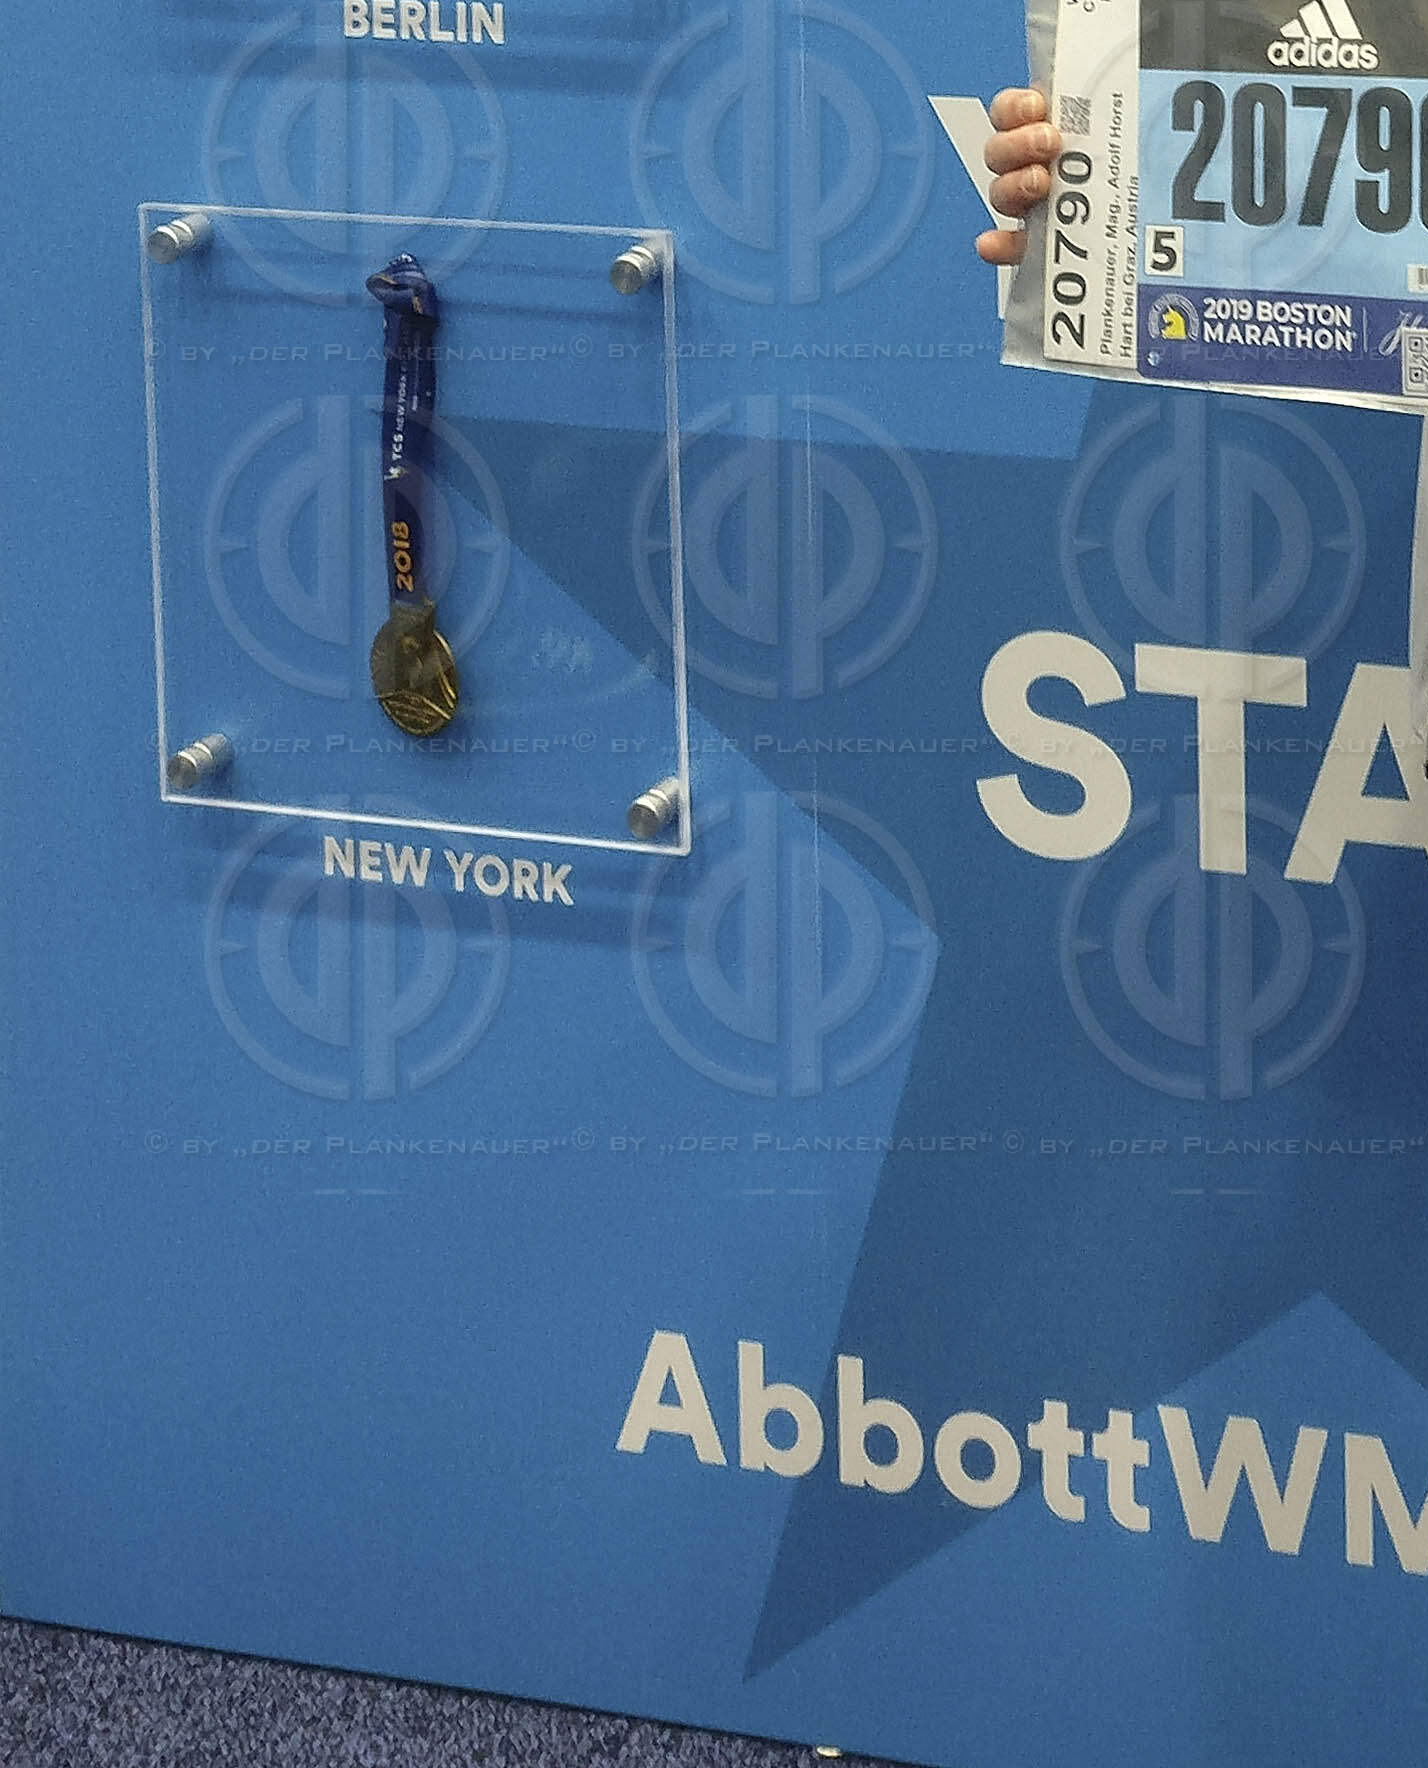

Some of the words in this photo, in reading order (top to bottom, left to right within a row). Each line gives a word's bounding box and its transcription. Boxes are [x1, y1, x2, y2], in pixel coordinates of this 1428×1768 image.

[1266, 35, 1381, 71] adidas
[1109, 91, 1124, 138] Horst
[1107, 144, 1122, 190] Adolf
[1051, 151, 1092, 350] 20790
[1150, 231, 1178, 272] 5
[1202, 296, 1252, 322] 2019
[1256, 299, 1353, 328] BOSTON
[1119, 321, 1134, 359] Hart
[392, 520, 413, 593] 2018
[323, 835, 432, 887] NEW
[443, 849, 574, 906] YORK
